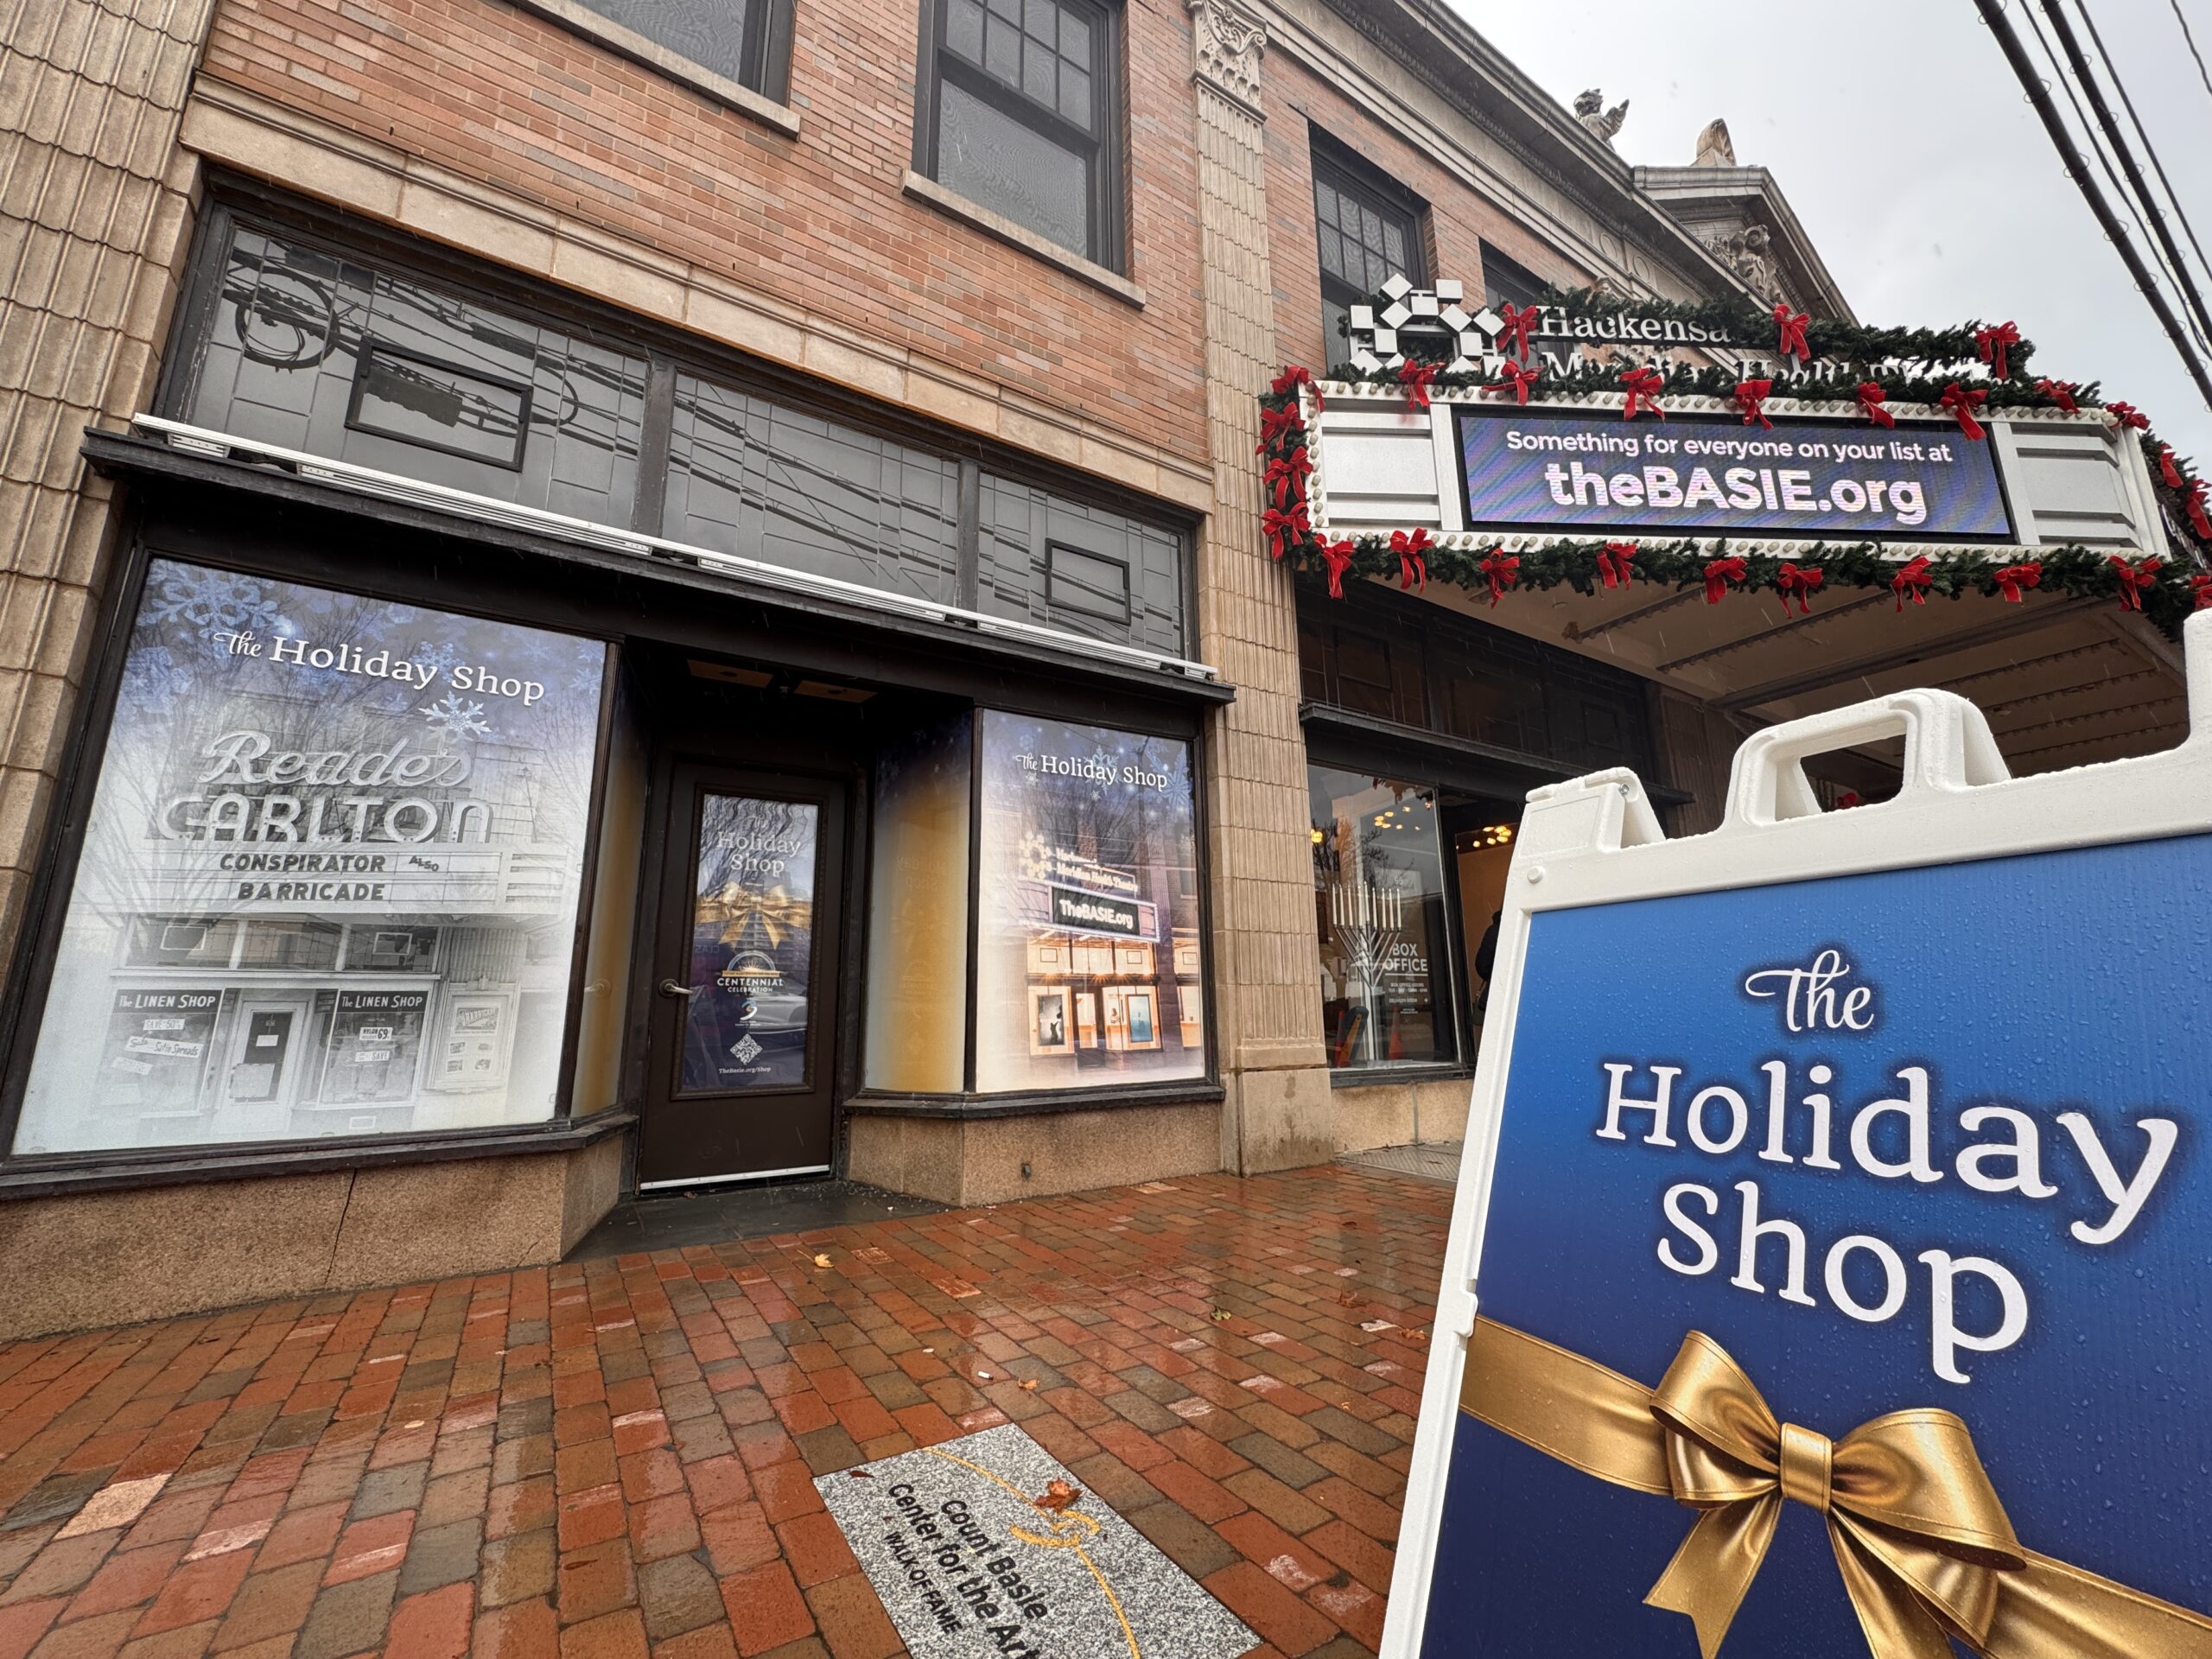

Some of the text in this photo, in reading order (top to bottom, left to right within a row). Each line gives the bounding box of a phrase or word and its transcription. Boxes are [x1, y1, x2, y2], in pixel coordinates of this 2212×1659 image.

[1535, 305, 1732, 343] Hackensa
[1506, 430, 1954, 464] Something for everyone on your list at
[1544, 460, 1929, 525] theBASIE.org
[213, 631, 545, 706] The Holiday Shop
[1015, 753, 1167, 792] The Holiday Shop
[715, 831, 802, 858] Holiday
[219, 853, 440, 873] CONSPIRATOR ALSO
[730, 852, 785, 878] Shop
[238, 882, 385, 901] BARRICADE
[1058, 899, 1134, 930] TheBASIE.org
[1384, 958, 1428, 972] OFFICE
[1392, 943, 1419, 957] BOX
[716, 977, 784, 987] CENTENNIAL
[1745, 949, 1875, 1033] The
[119, 995, 216, 1008] The LINEN SHOP
[341, 996, 353, 1007] The
[355, 995, 389, 1008] LINEN
[391, 995, 423, 1008] SHOP
[1595, 1060, 2179, 1245] Holiday
[1656, 1181, 2029, 1384] Shop
[888, 1484, 944, 1542] Center
[931, 1542, 969, 1574] for
[957, 1575, 1000, 1620] the
[940, 1500, 1048, 1620] Count Basie
[883, 1531, 963, 1635] WALK OF FAME
